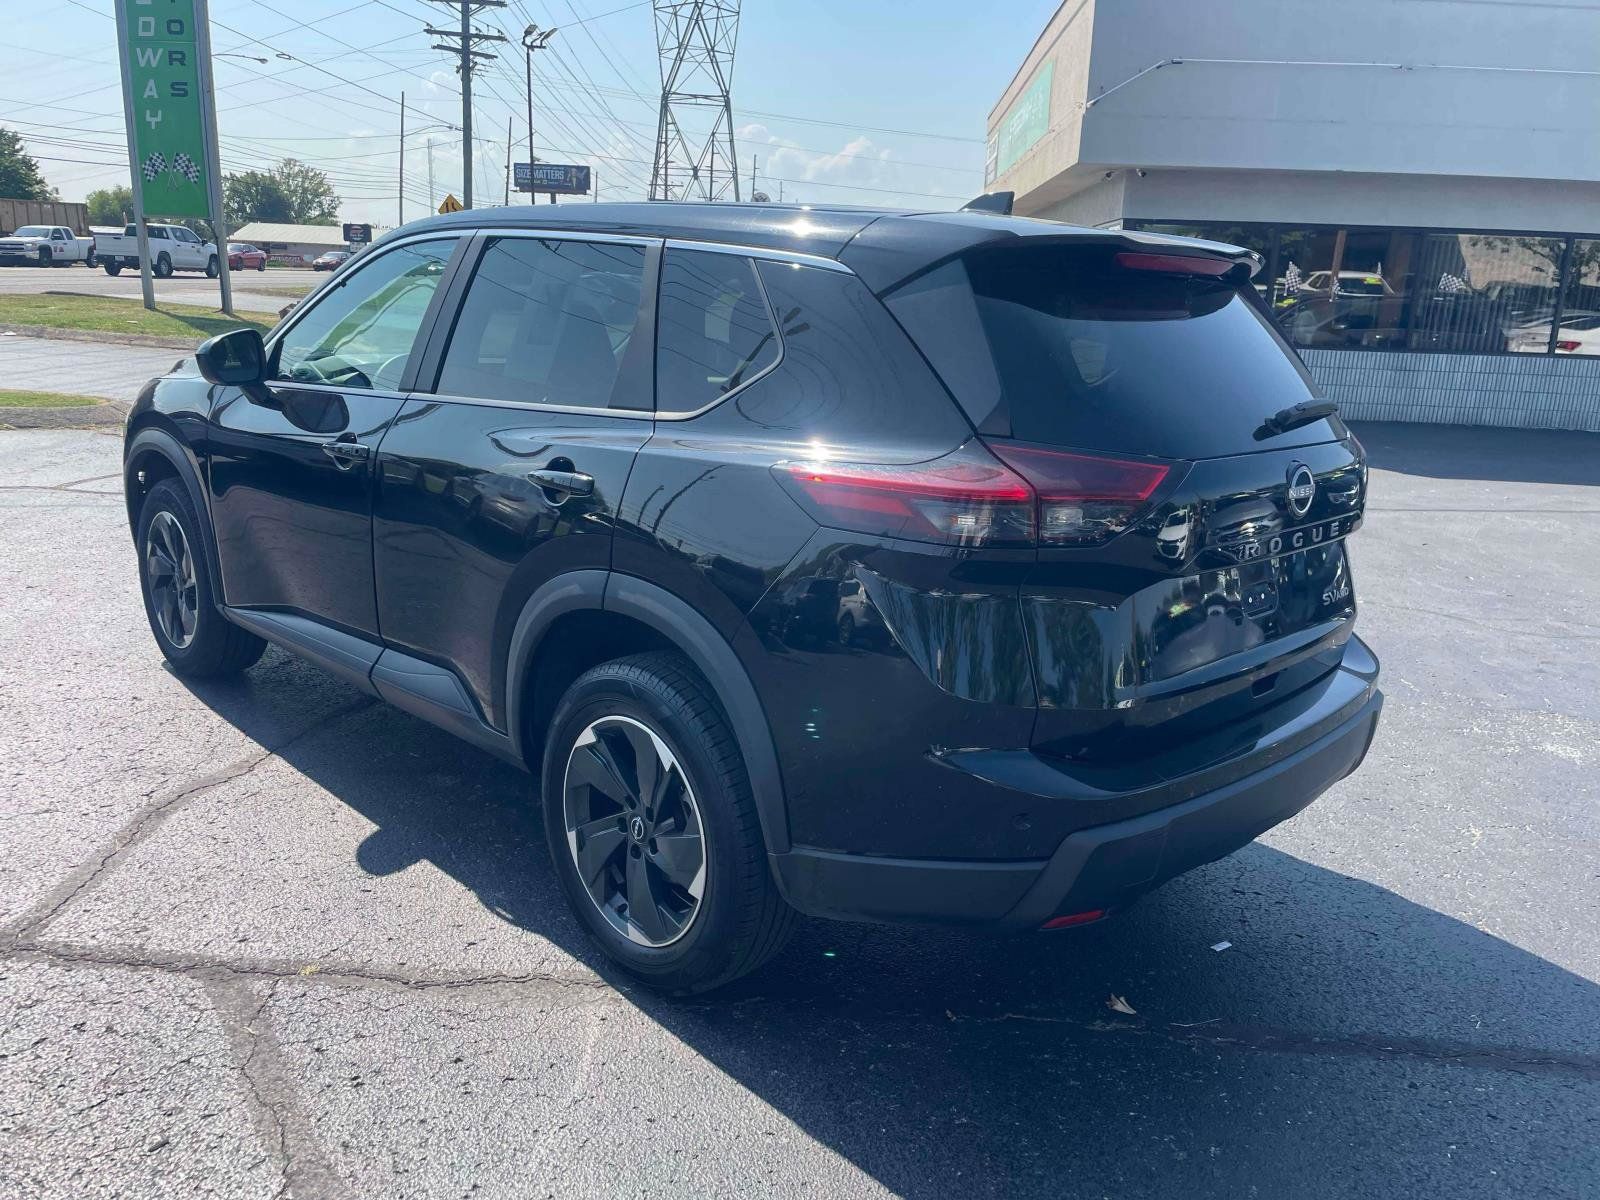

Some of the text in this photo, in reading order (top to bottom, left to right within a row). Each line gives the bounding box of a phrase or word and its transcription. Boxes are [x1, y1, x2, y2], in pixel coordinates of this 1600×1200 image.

[136, 0, 163, 129] DWAY
[166, 0, 188, 97] ORS
[1244, 522, 1339, 559] ROGUE
